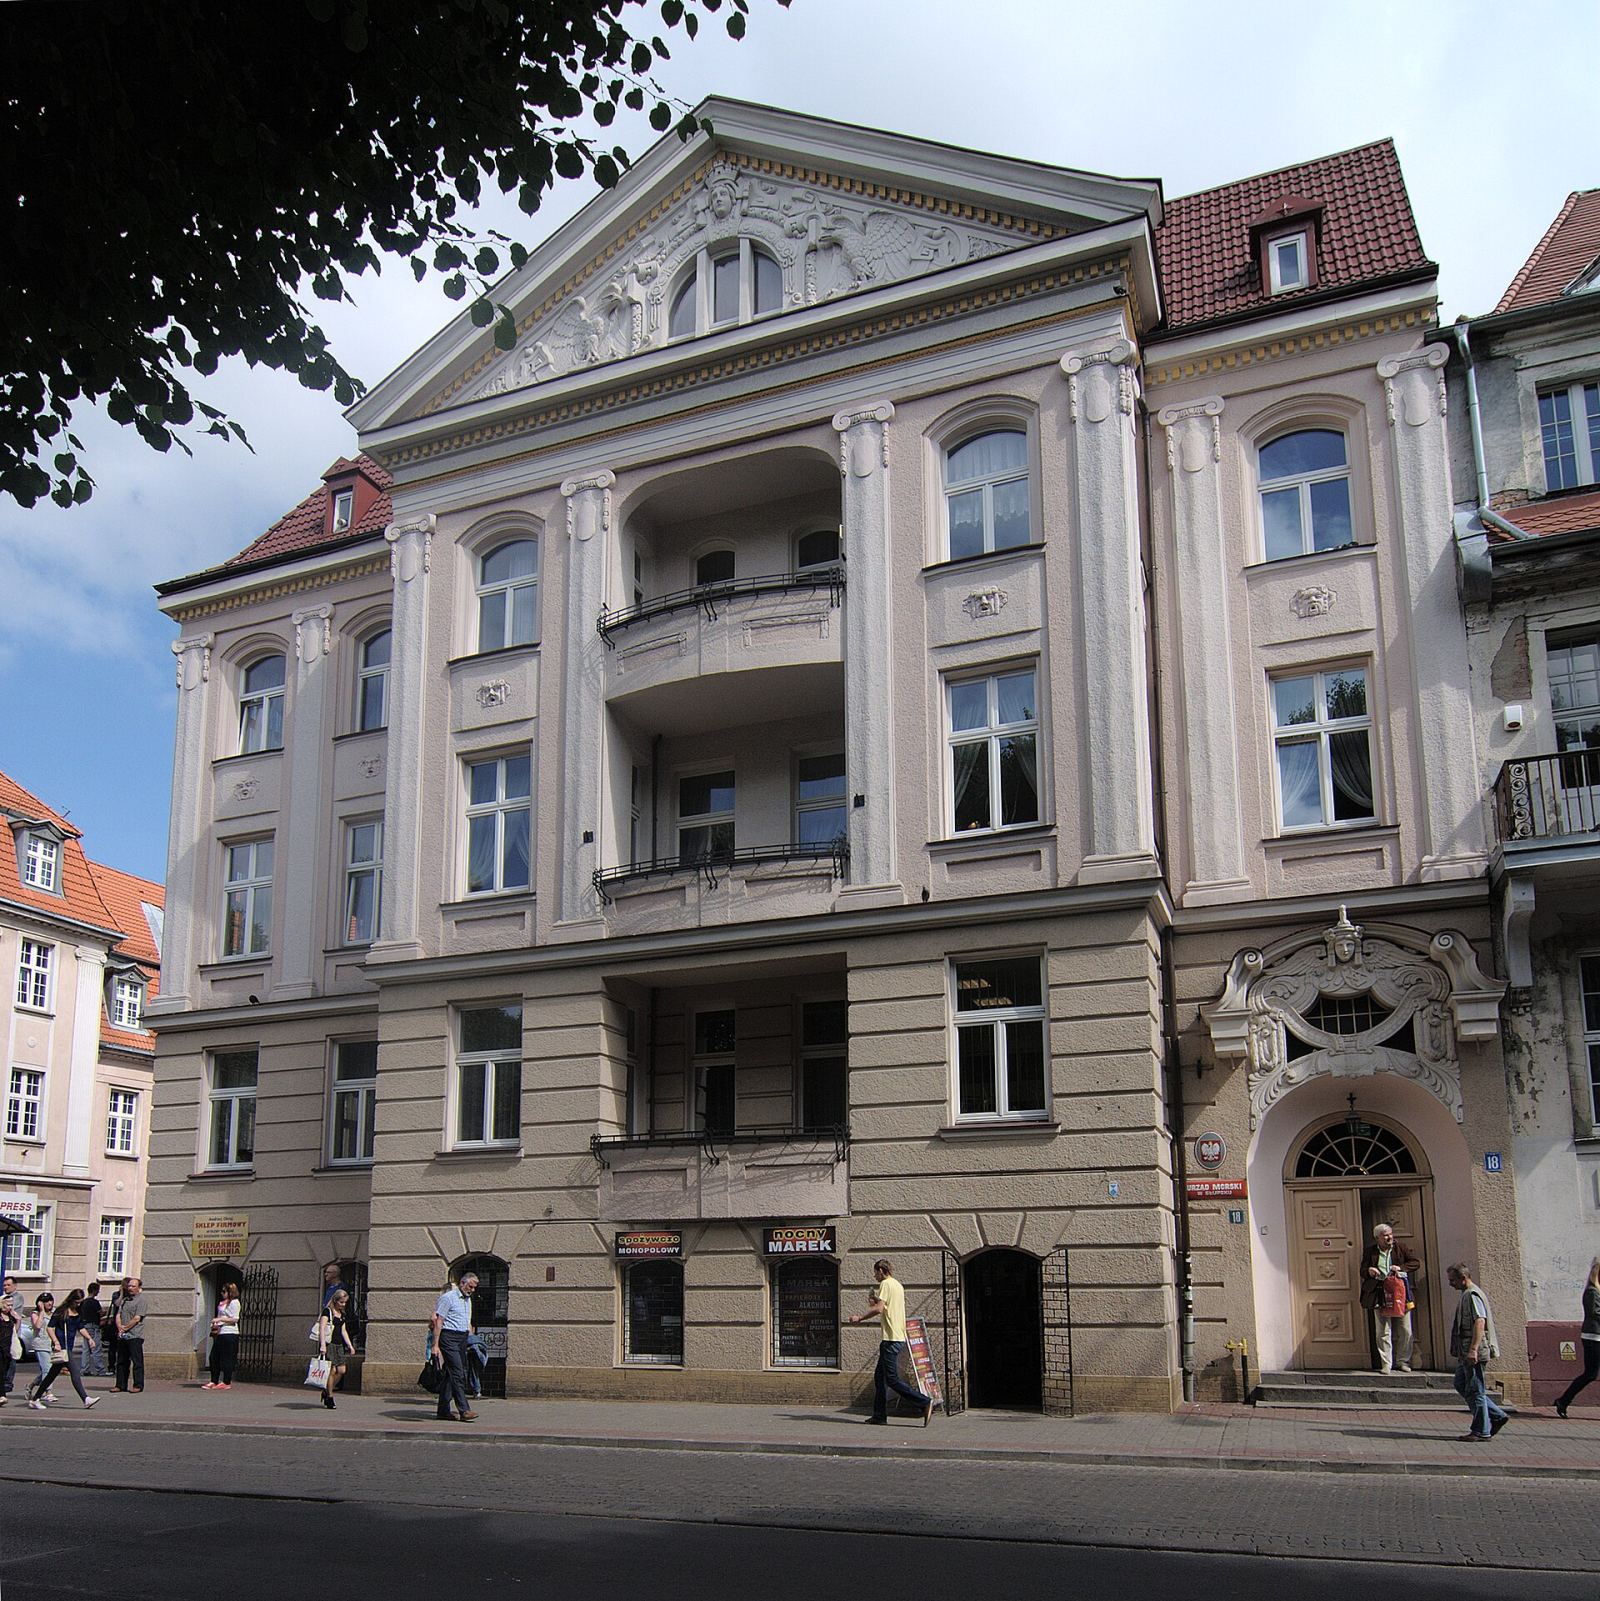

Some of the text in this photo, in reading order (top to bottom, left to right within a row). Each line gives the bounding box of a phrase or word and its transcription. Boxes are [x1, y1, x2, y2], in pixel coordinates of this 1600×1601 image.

[1487, 1155, 1499, 1169] 18
[0, 1201, 32, 1211] PRESS
[1231, 1211, 1241, 1223] 18
[773, 1229, 826, 1240] nocny
[768, 1240, 832, 1252] MAREK
[786, 1279, 830, 1287] MAREK
[799, 1301, 833, 1309] ALKOHOLE
